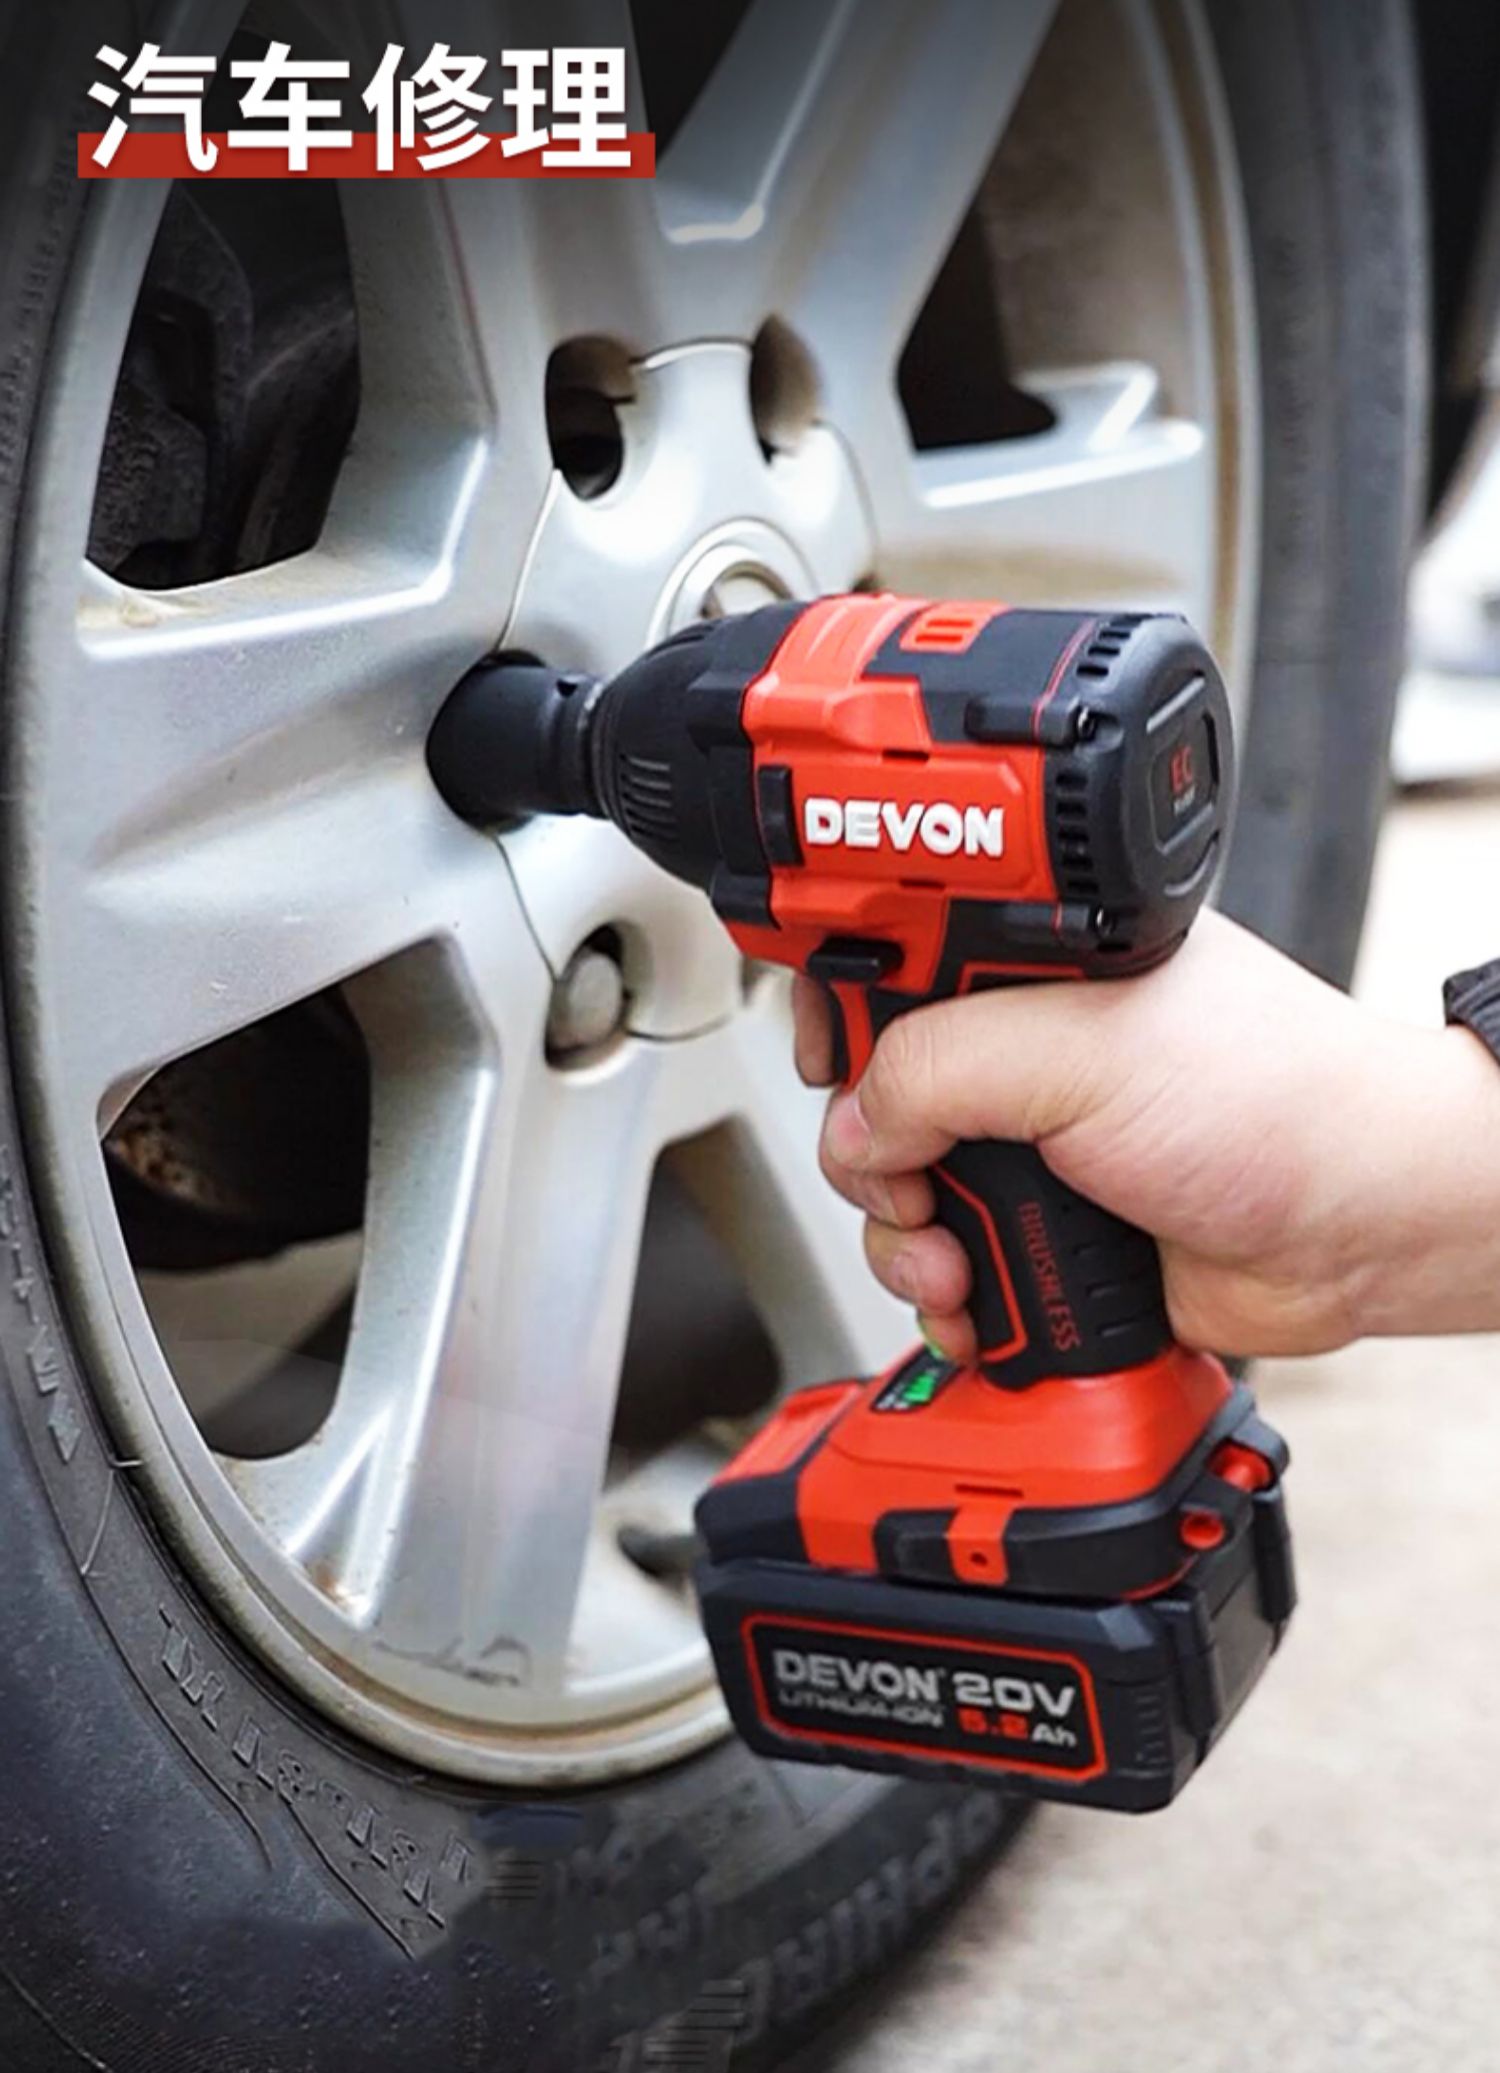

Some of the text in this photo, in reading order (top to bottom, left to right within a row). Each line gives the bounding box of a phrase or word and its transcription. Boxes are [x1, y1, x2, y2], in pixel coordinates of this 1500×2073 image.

[804, 797, 1005, 857] DEVON
[773, 1650, 1076, 1718] DEVON 20V
